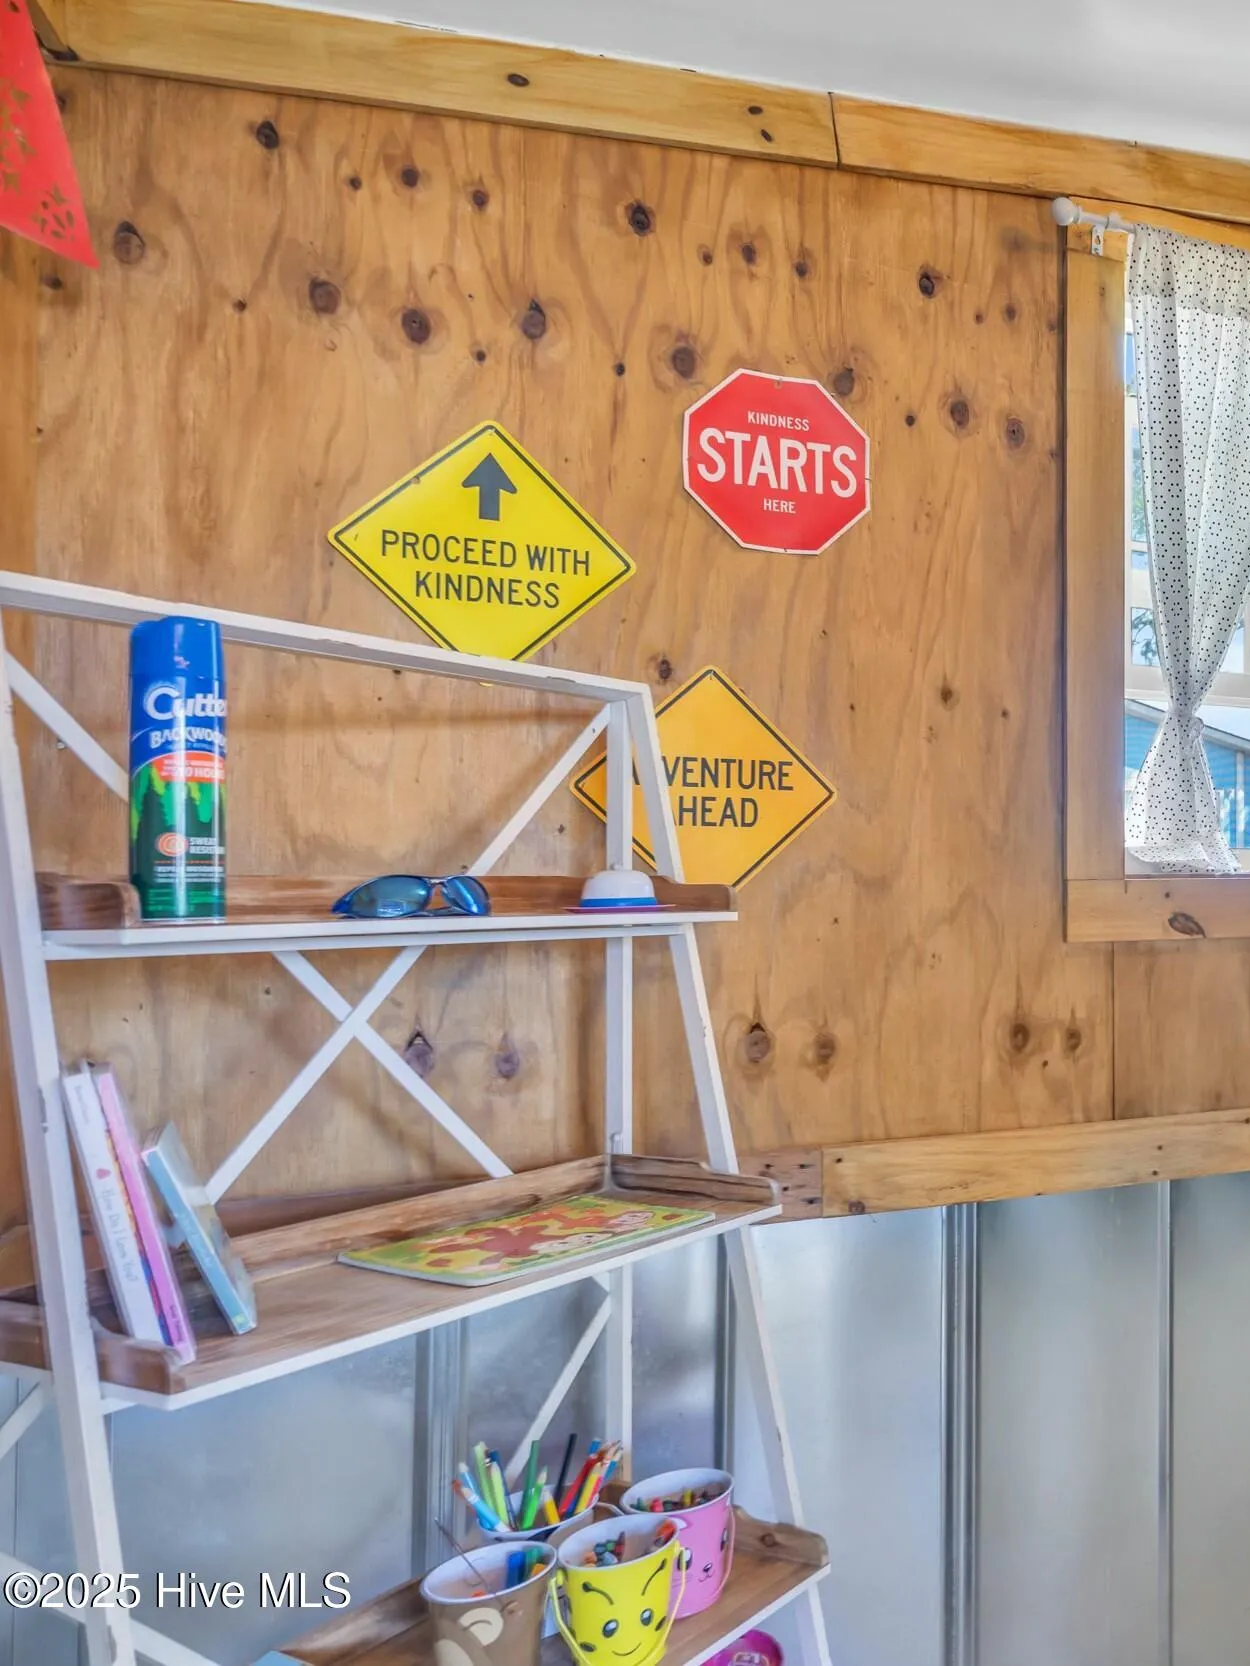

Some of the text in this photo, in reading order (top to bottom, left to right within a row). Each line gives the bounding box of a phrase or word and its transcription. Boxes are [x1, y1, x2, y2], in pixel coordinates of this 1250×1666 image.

[747, 411, 810, 432] KINDNESS
[697, 427, 857, 498] STARTS
[763, 498, 796, 514] HERE
[381, 529, 590, 576] PROCEED WITH
[415, 570, 560, 609] KINDNESS
[632, 755, 794, 791] VENTURE
[672, 795, 759, 828] HEAD
